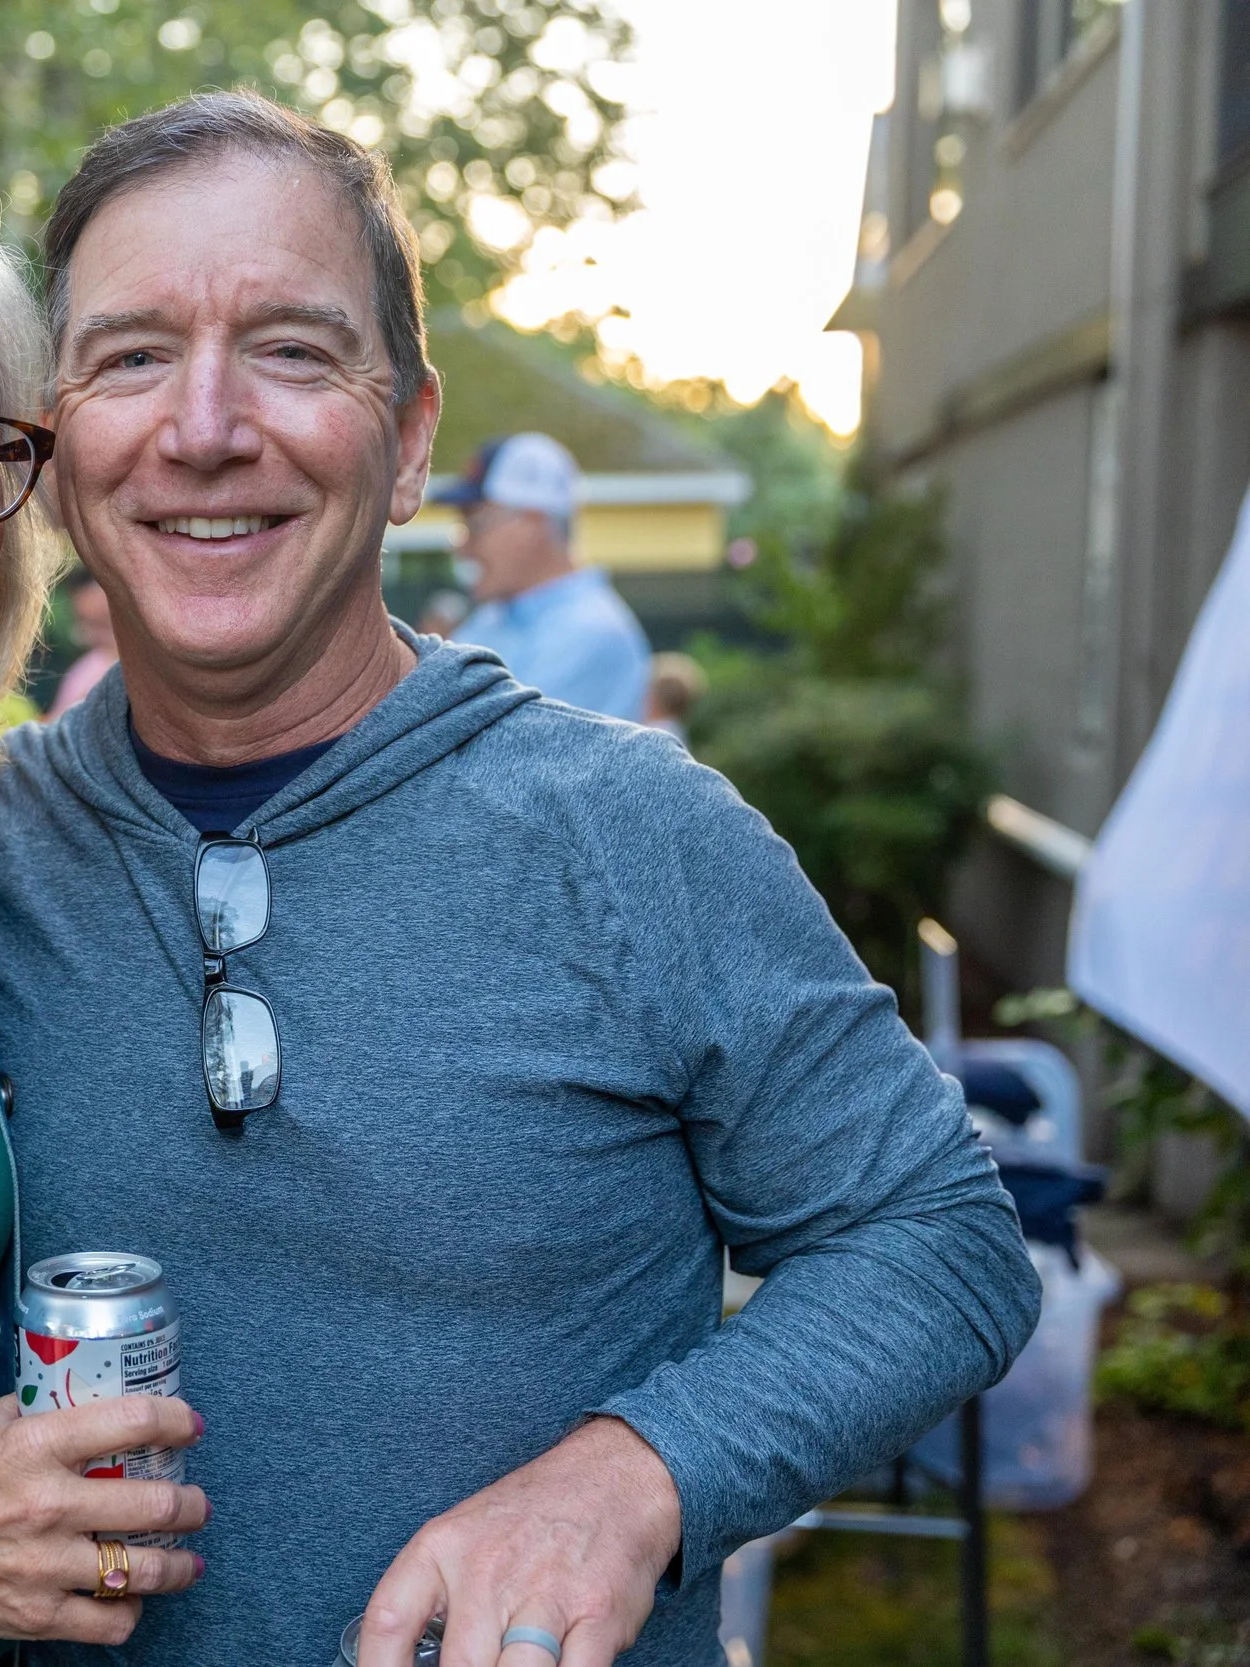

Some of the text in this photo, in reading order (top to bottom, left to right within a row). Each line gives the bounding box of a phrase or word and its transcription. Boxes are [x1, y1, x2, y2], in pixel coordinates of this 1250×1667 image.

[138, 1305, 164, 1319] Sodium
[121, 1334, 166, 1352] CONTAINS 0% JUICE
[124, 1347, 168, 1367] Nutrition
[169, 1339, 181, 1354] Fac
[124, 1369, 147, 1378] Serving
[147, 1365, 158, 1373] size
[125, 1385, 144, 1393] Amount
[152, 1378, 167, 1388] serving
